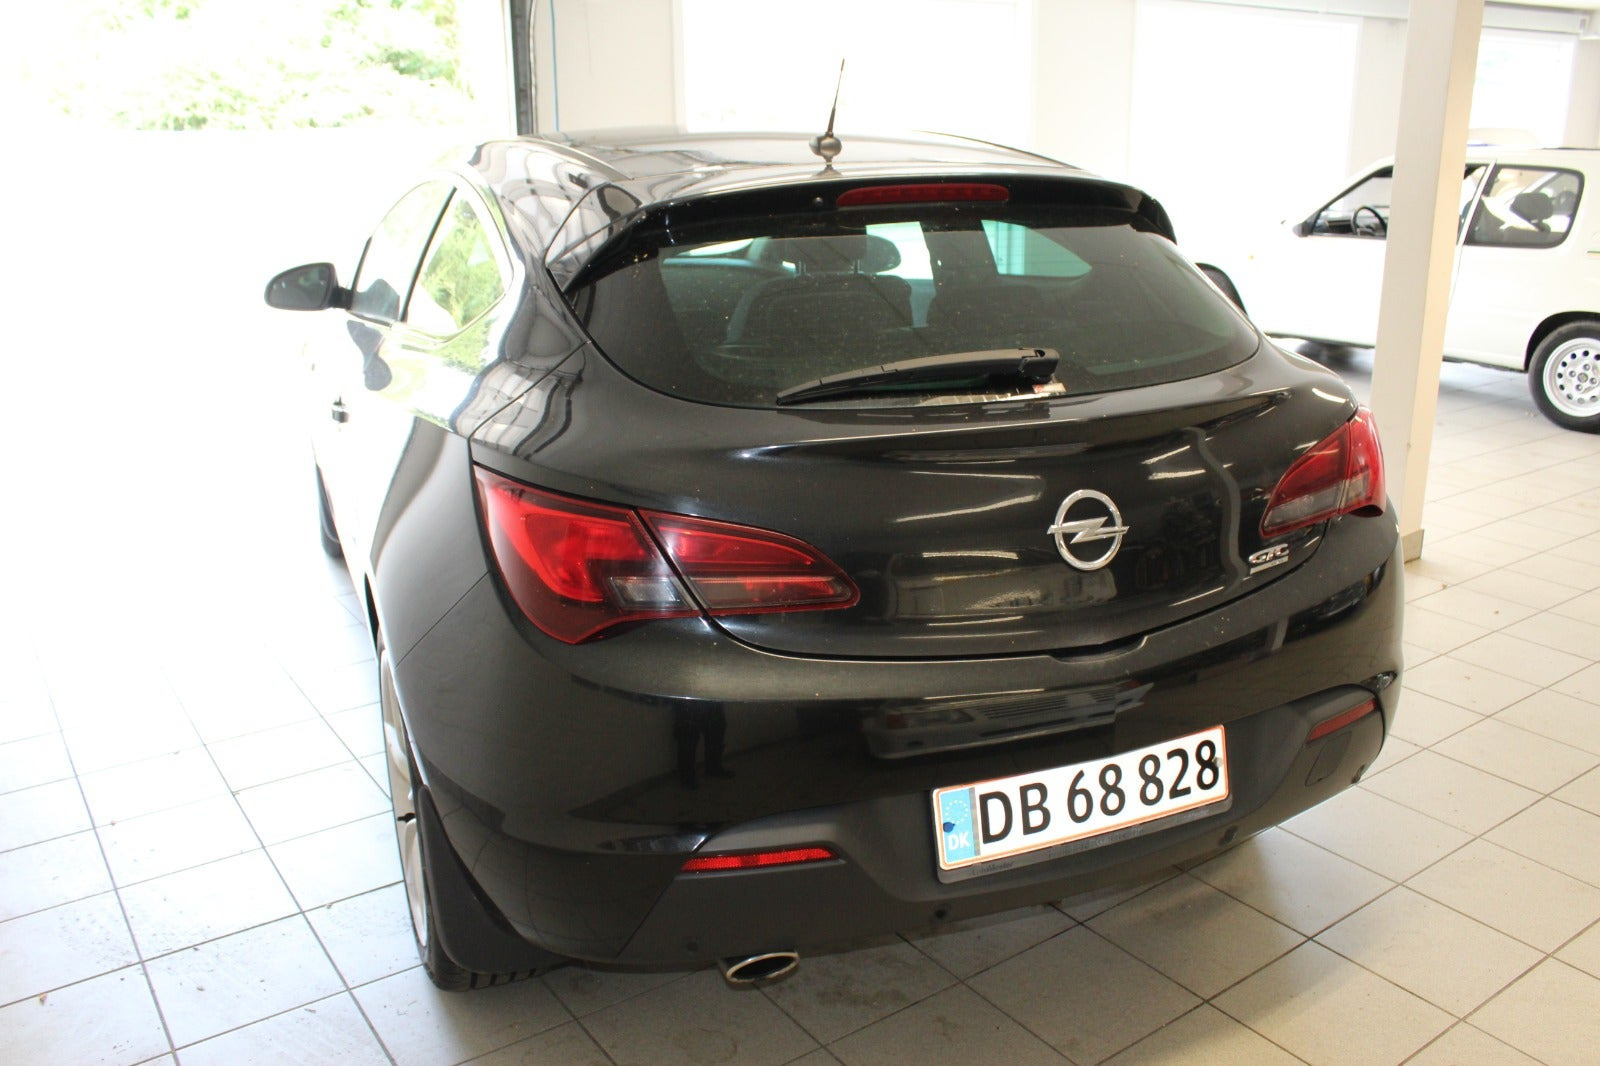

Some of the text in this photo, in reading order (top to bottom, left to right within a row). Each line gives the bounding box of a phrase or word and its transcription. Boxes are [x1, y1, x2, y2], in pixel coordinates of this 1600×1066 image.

[1249, 543, 1289, 564] GTC
[979, 782, 1051, 844] DB
[1067, 763, 1126, 823] 68
[1138, 739, 1220, 806] 828
[948, 832, 972, 851] DK
